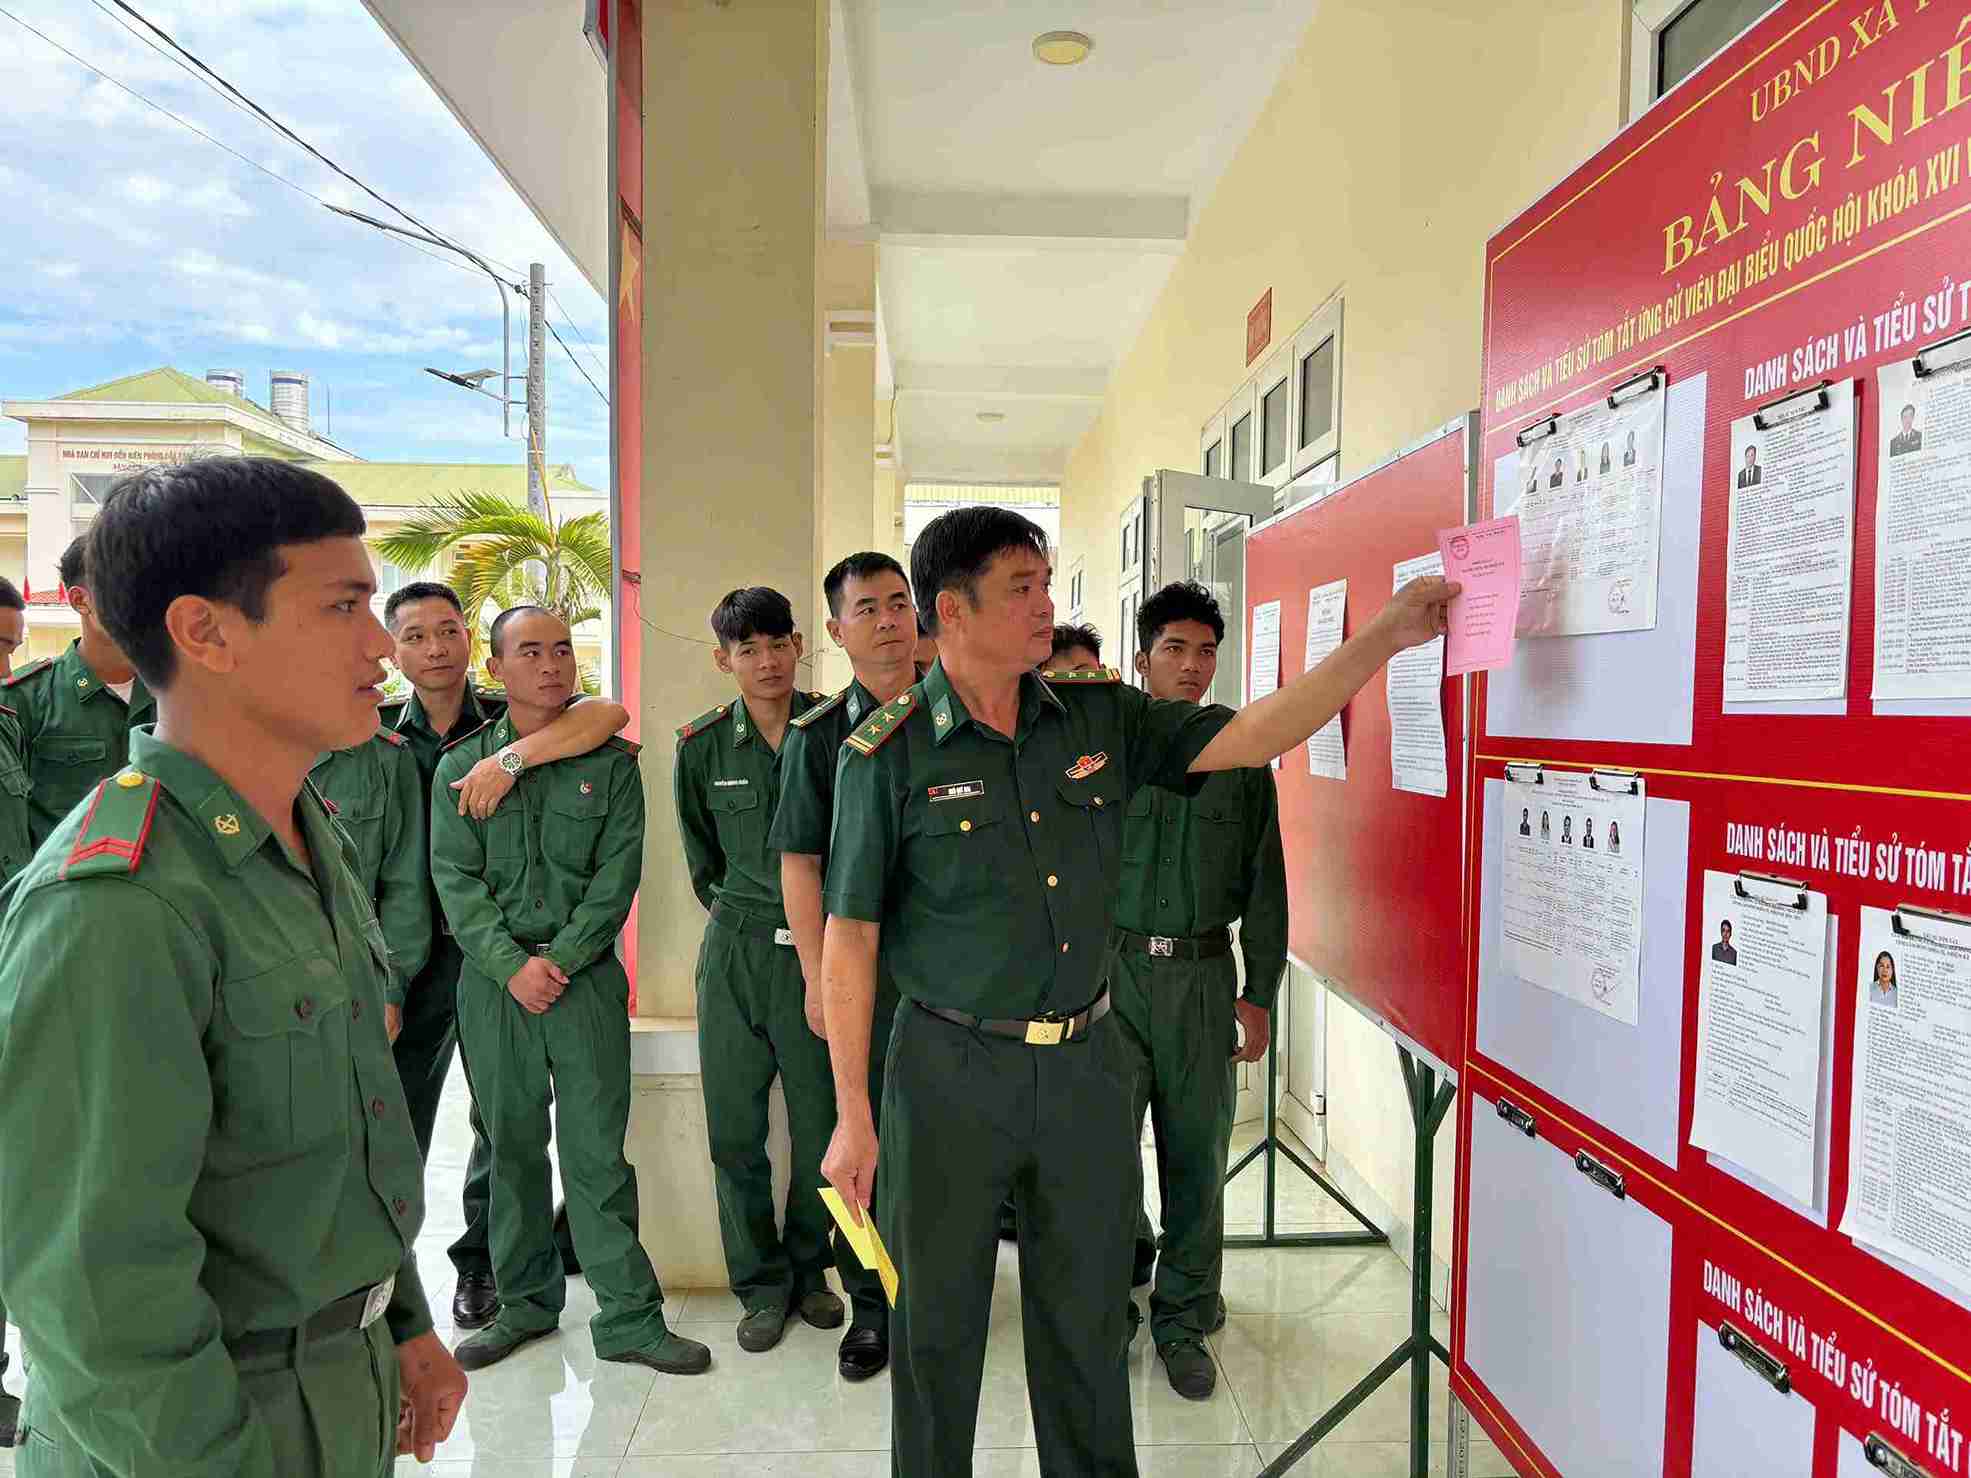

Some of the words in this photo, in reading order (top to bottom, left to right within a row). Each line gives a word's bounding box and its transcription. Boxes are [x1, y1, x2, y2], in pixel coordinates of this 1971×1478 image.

[1750, 36, 1841, 122] UBND
[1592, 328, 1614, 366] TÓM
[1616, 310, 1635, 352] TẮT
[1638, 303, 1663, 343] ỨNG
[1665, 282, 1683, 329] CỬ
[1685, 273, 1714, 319] VIÊN
[1717, 260, 1741, 305] ĐẠI
[1744, 229, 1779, 288] BIỂU
[1783, 205, 1827, 271] QUỐC
[1831, 192, 1861, 246] HỘI
[1867, 164, 1919, 227] KHÓA
[1924, 143, 1960, 199] XVI
[1661, 131, 1826, 275] BẢNG
[1744, 353, 1788, 400] DANH
[1791, 333, 1839, 383] SÁCH
[1844, 315, 1867, 363] VÀ
[1872, 290, 1916, 353] TIỂU
[1922, 275, 1955, 335] SỬ
[1726, 822, 1764, 859] DANH
[1767, 822, 1807, 866] SÁCH
[1810, 828, 1830, 871] VÀ
[1834, 825, 1871, 878] TIỂU
[1874, 832, 1902, 884] SỬ
[1905, 841, 1946, 891] TÓM
[1703, 1258, 1741, 1312] DANH
[1744, 1287, 1783, 1342] SÁCH
[1786, 1316, 1807, 1360] VÀ
[1810, 1332, 1846, 1389] TIỂU
[1850, 1358, 1876, 1409] SỬ
[1879, 1380, 1920, 1445] TÓM
[1926, 1408, 1963, 1472] TẮT
